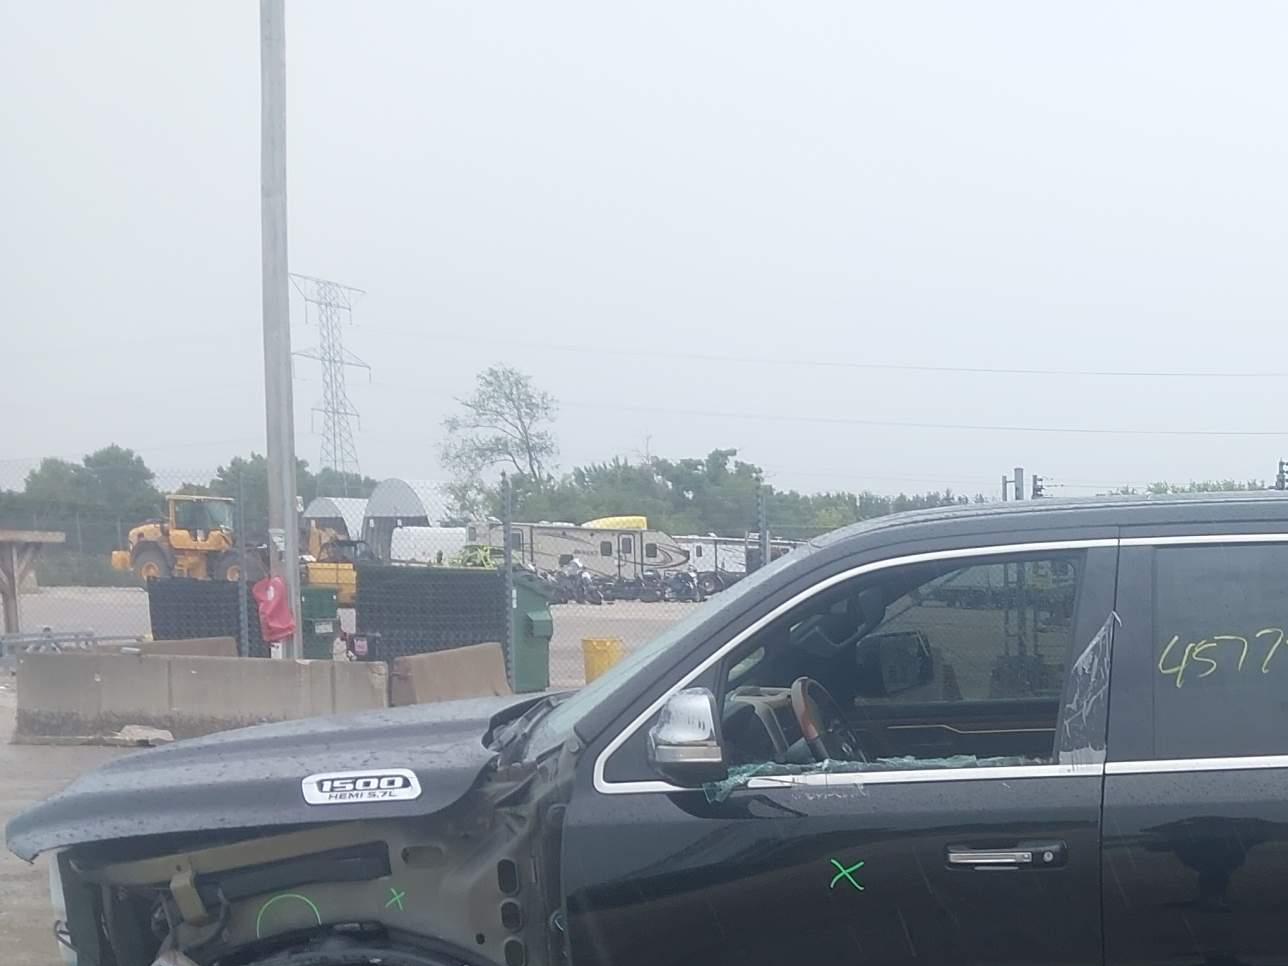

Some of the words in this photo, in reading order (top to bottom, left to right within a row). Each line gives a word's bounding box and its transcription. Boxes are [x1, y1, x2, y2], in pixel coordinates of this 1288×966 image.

[321, 776, 404, 793] 1500
[328, 791, 364, 801] HEMI
[368, 790, 398, 799] 5.7L
